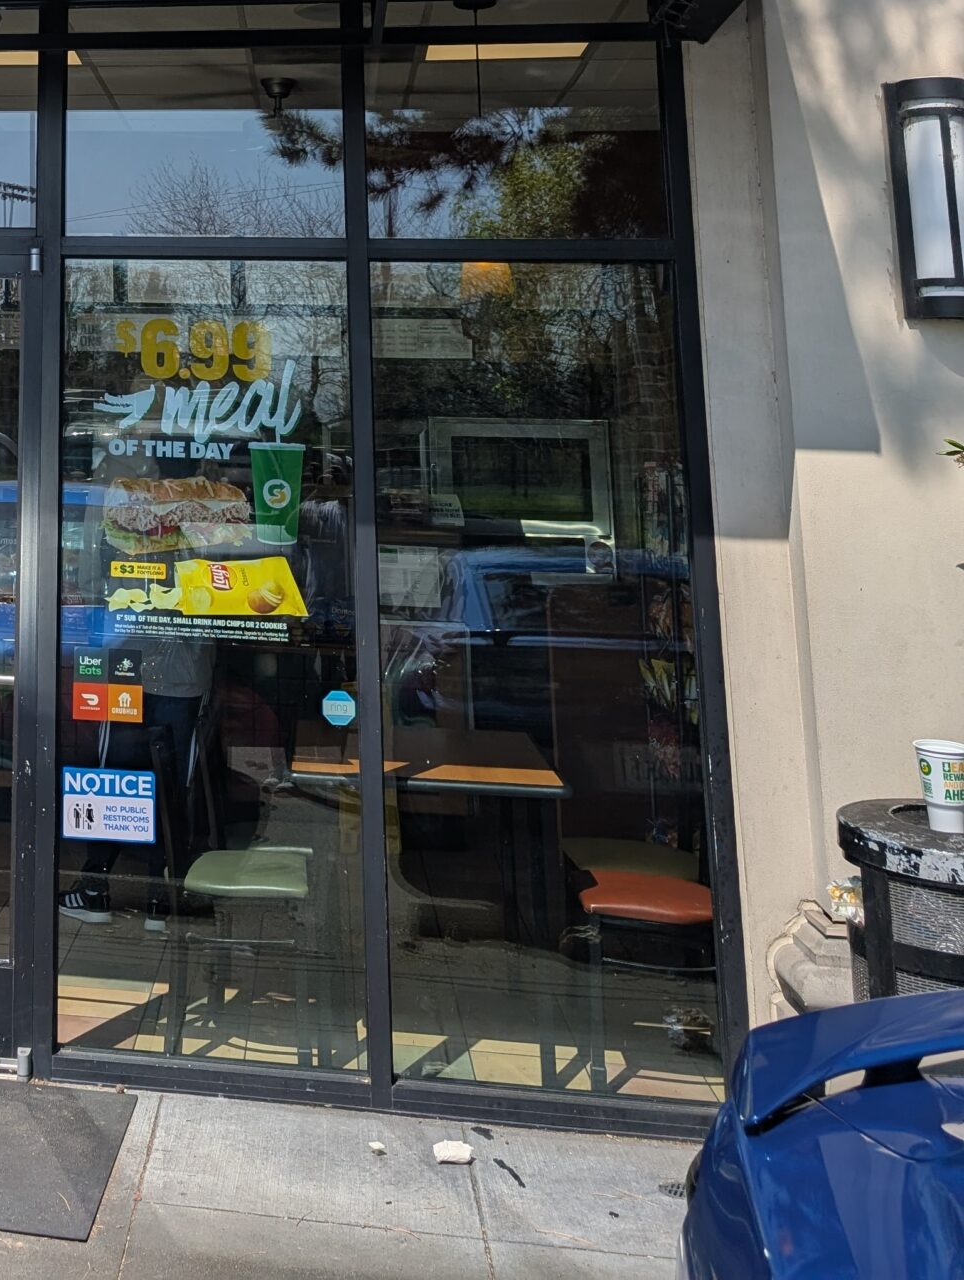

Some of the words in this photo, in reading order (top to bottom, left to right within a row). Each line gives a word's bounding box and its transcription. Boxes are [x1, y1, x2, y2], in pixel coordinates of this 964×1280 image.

[115, 318, 273, 382] $6.99
[160, 359, 302, 444] meal
[108, 439, 139, 456] OF
[142, 440, 186, 458] THE
[190, 441, 235, 460] DAY
[119, 564, 135, 575] $3
[209, 563, 231, 590] Lay's
[124, 614, 137, 622] SUB
[137, 615, 146, 623] OF
[158, 616, 172, 624] DAY,
[172, 617, 192, 625] SMALL
[193, 618, 212, 626] DRINK
[212, 619, 226, 627] AND
[226, 620, 245, 628] CHIPS
[260, 622, 288, 630] COOKIES
[79, 655, 102, 666] Uber
[79, 665, 102, 676] Eats
[330, 703, 348, 714] ring
[64, 772, 153, 796] NOTICE
[105, 805, 117, 813] NO
[120, 806, 147, 814] PUBLIC
[103, 814, 150, 823] RESTROOMS
[104, 823, 130, 832] THANK
[132, 825, 149, 833] YOU
